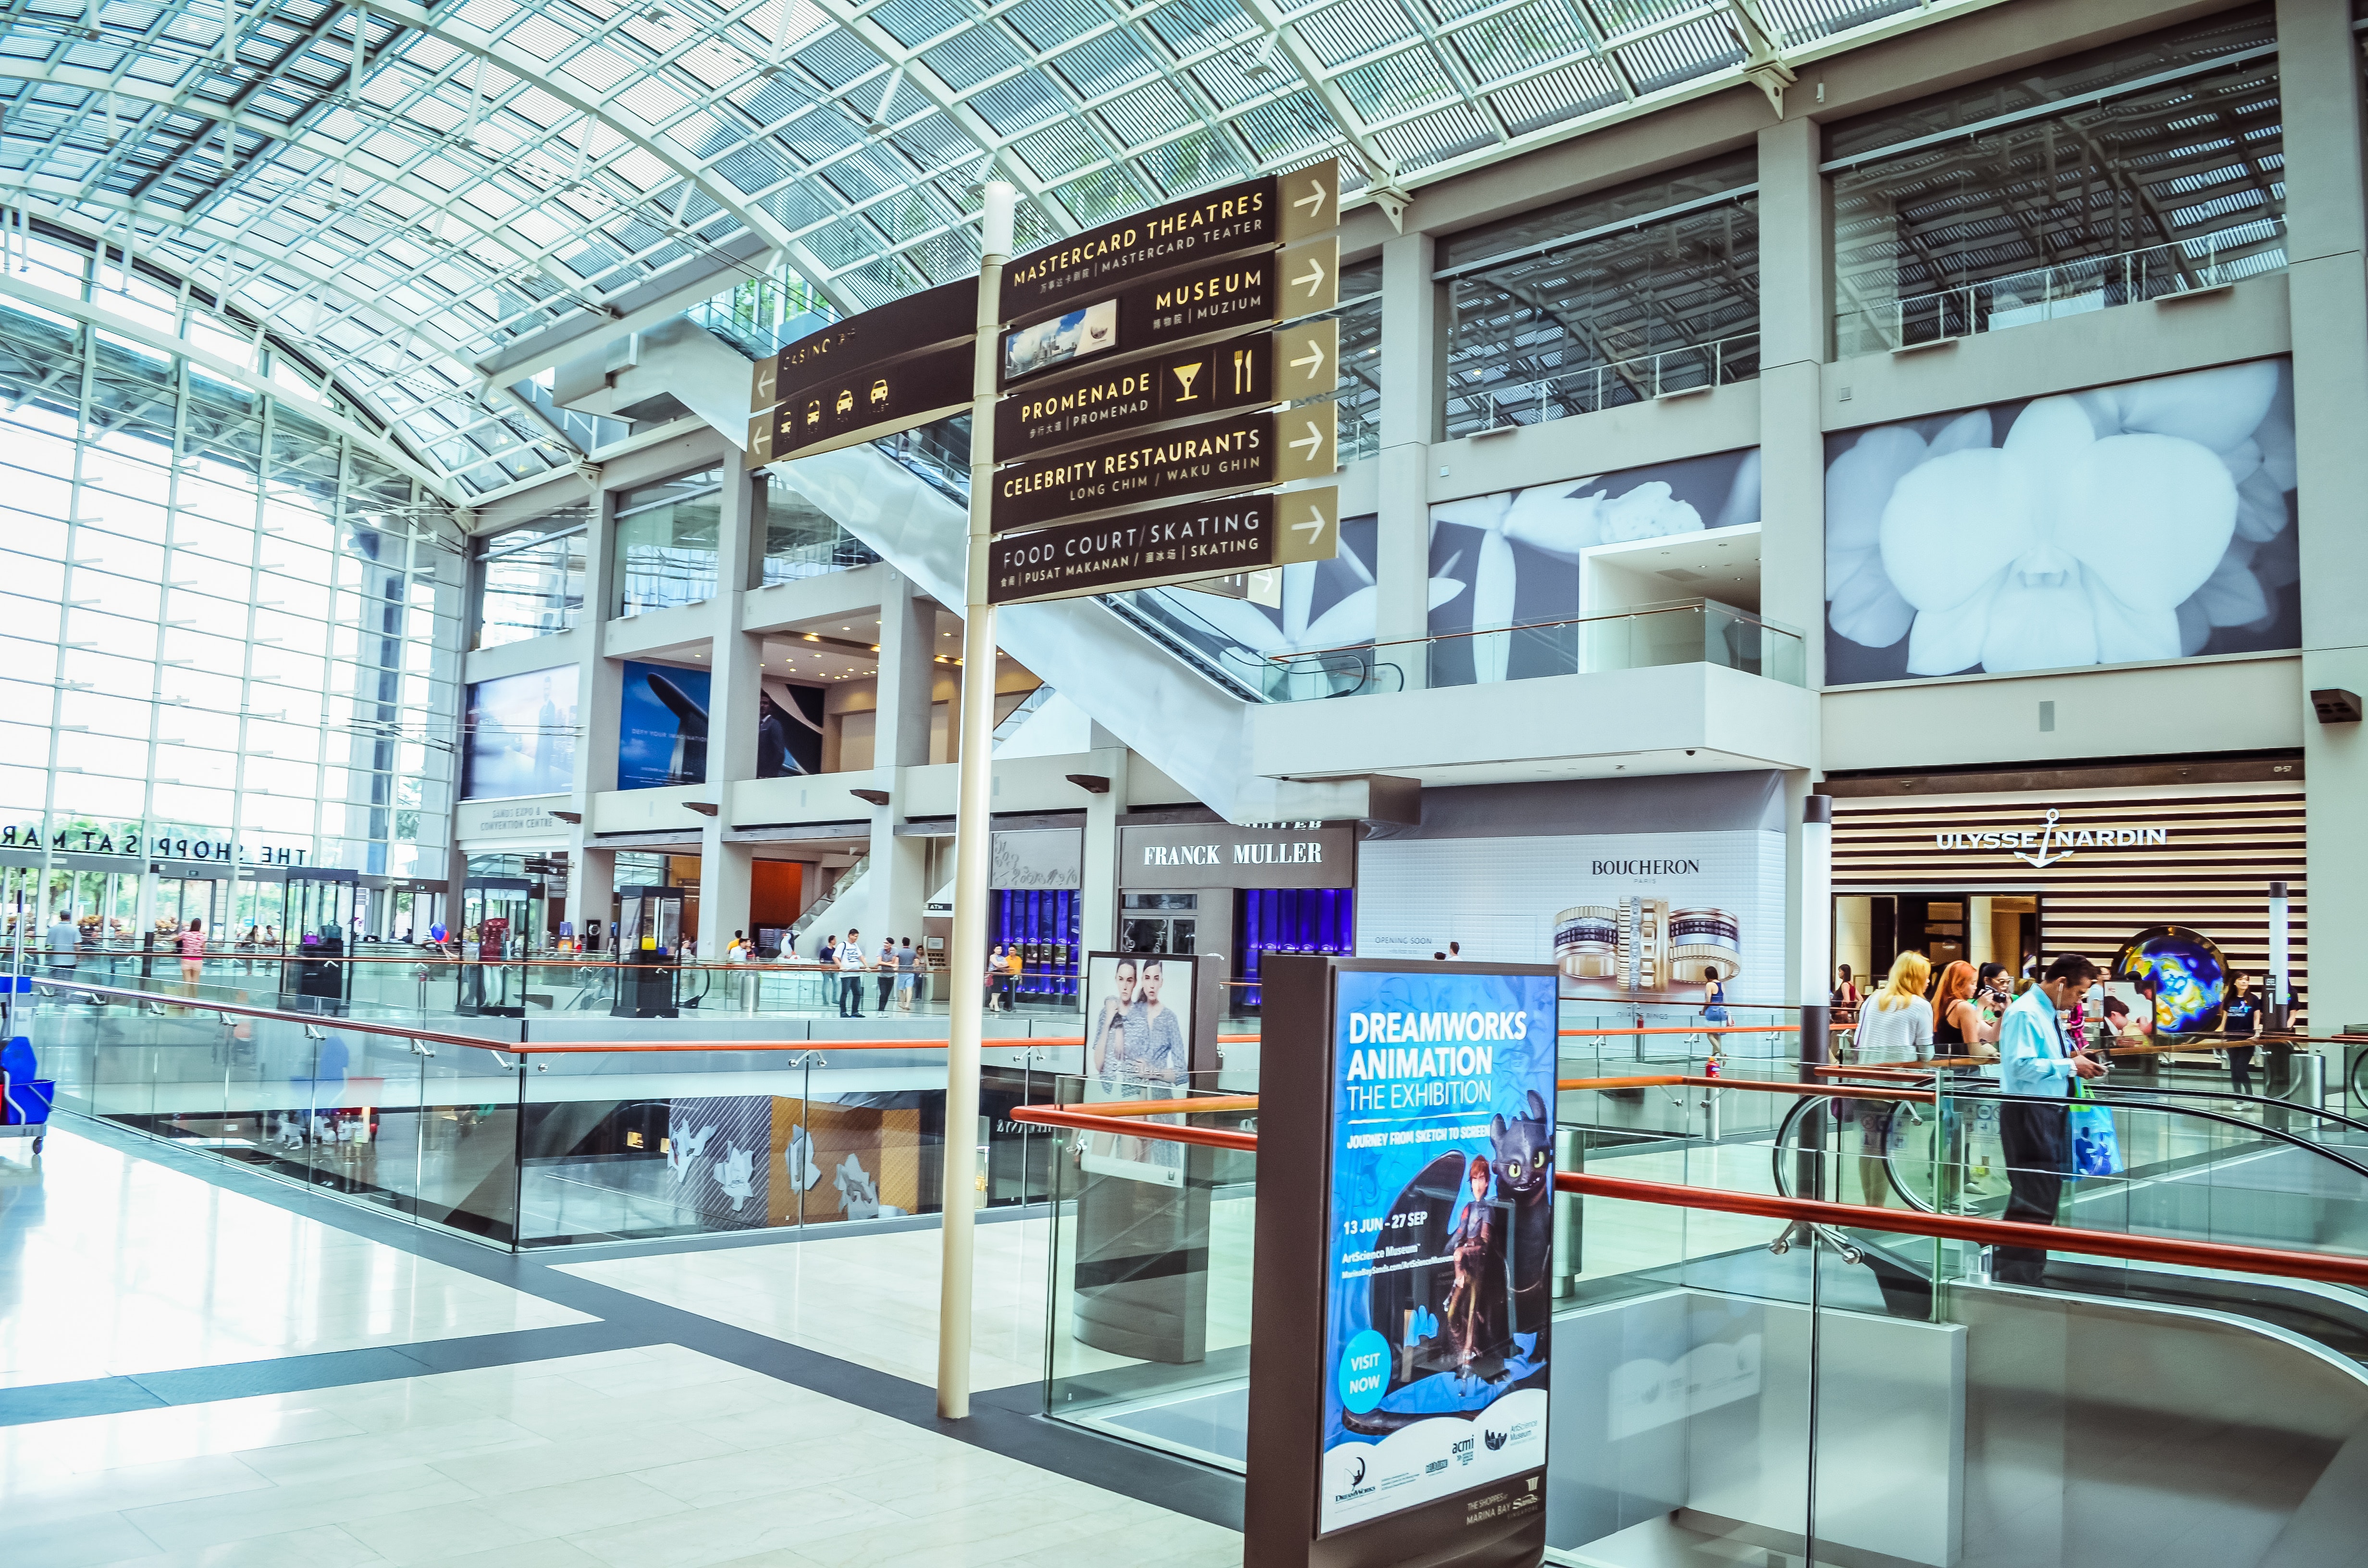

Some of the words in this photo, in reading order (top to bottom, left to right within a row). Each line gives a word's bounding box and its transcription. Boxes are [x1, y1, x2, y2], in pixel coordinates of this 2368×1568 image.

[1014, 230, 1136, 286] MASTERCARD
[1147, 193, 1263, 240] THEATRES
[1102, 236, 1195, 272] MASTERCARD
[1203, 219, 1262, 243] TEATER
[1156, 270, 1262, 310] MUSEUM
[1197, 295, 1262, 318] MUZIUM
[1022, 373, 1150, 422] PROMENADE
[1073, 400, 1148, 427] PROMENAD
[1004, 460, 1096, 498] CELEBRITY
[1105, 429, 1259, 474] RESTAURANTS
[1070, 483, 1105, 500] LONG
[1112, 476, 1148, 492] CHIM
[1167, 464, 1210, 480] WAKU
[1219, 456, 1260, 473] GHIN
[1004, 544, 1055, 569] FOOD
[1191, 538, 1259, 557] SKATING
[1025, 567, 1061, 583] PUSAT
[1066, 555, 1129, 576] MAKANAN
[1937, 832, 2038, 849] ULYSSE
[2056, 829, 2167, 846] NARDIN
[1144, 845, 1221, 865] FRANCK
[1233, 842, 1322, 864] MULLER
[1592, 859, 1699, 875] BOUCHERON
[1350, 1011, 1527, 1043] DREAMWORKS
[1346, 1046, 1492, 1081] ANIMATION
[1346, 1085, 1385, 1111] THE
[1391, 1080, 1492, 1109] EXHIBITION
[1347, 1133, 1388, 1149] JOURNEY
[1389, 1131, 1414, 1145] FROM
[1415, 1128, 1447, 1142] SKETCH
[1449, 1127, 1459, 1140] TO
[1344, 1221, 1357, 1235] 13
[1359, 1217, 1383, 1233] JUN
[1392, 1214, 1406, 1229] 27
[1408, 1211, 1428, 1227] SEP
[1342, 1250, 1385, 1264] ArtScience
[1351, 1353, 1381, 1372] VISIT
[1350, 1375, 1380, 1394] NOW
[1452, 1434, 1474, 1454] acmi
[1467, 1508, 1496, 1525] MARINA
[1497, 1503, 1511, 1515] BAY
